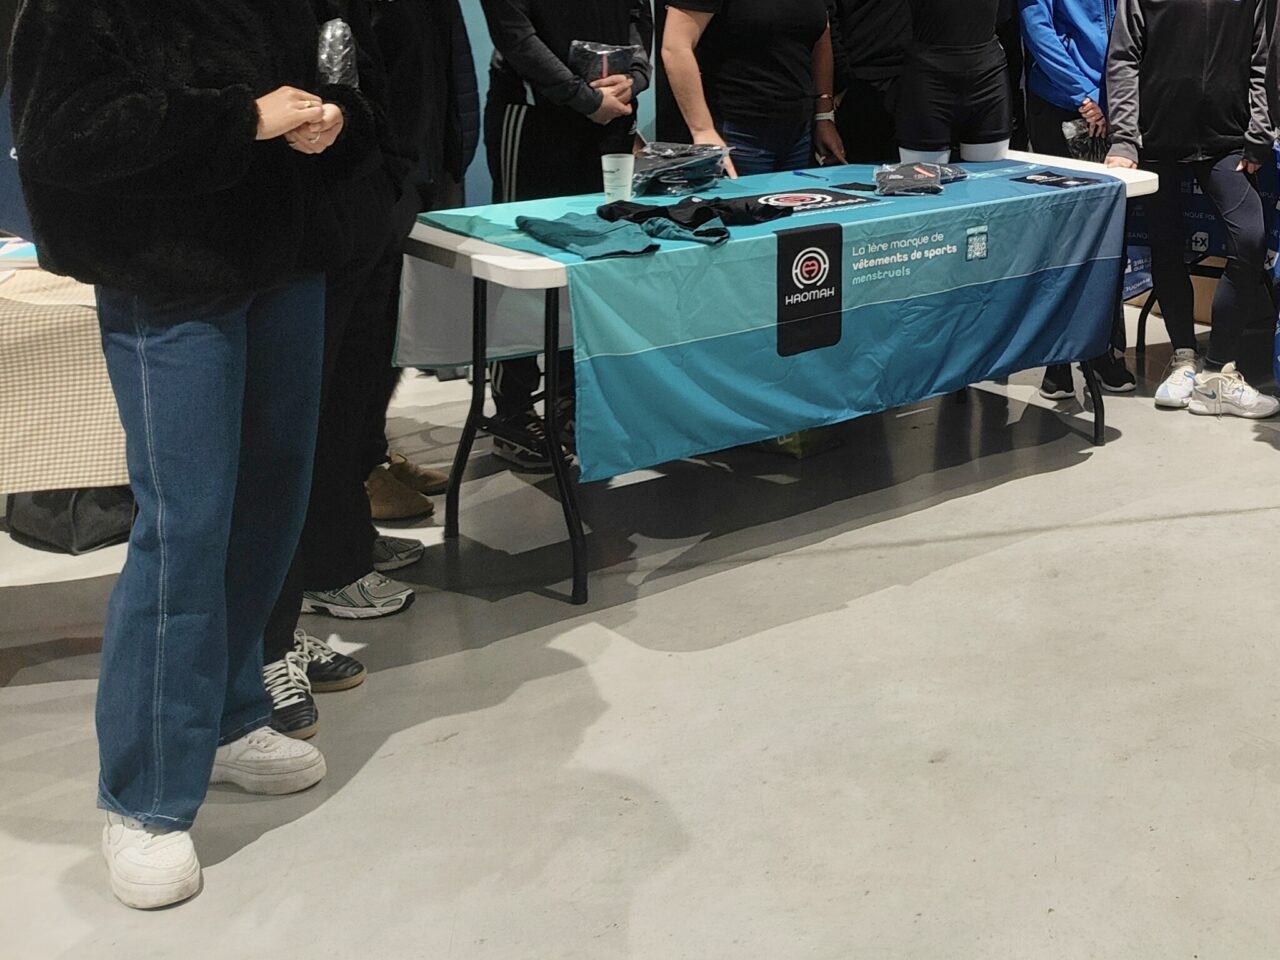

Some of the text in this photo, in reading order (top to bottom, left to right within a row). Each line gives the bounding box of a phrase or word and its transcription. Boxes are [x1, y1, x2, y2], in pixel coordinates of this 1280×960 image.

[852, 246, 865, 256] La
[890, 235, 929, 248] marque
[931, 232, 944, 242] de
[852, 244, 957, 270] vêtements de sports
[852, 266, 911, 285] menstruels
[784, 286, 835, 305] HAOMAH
